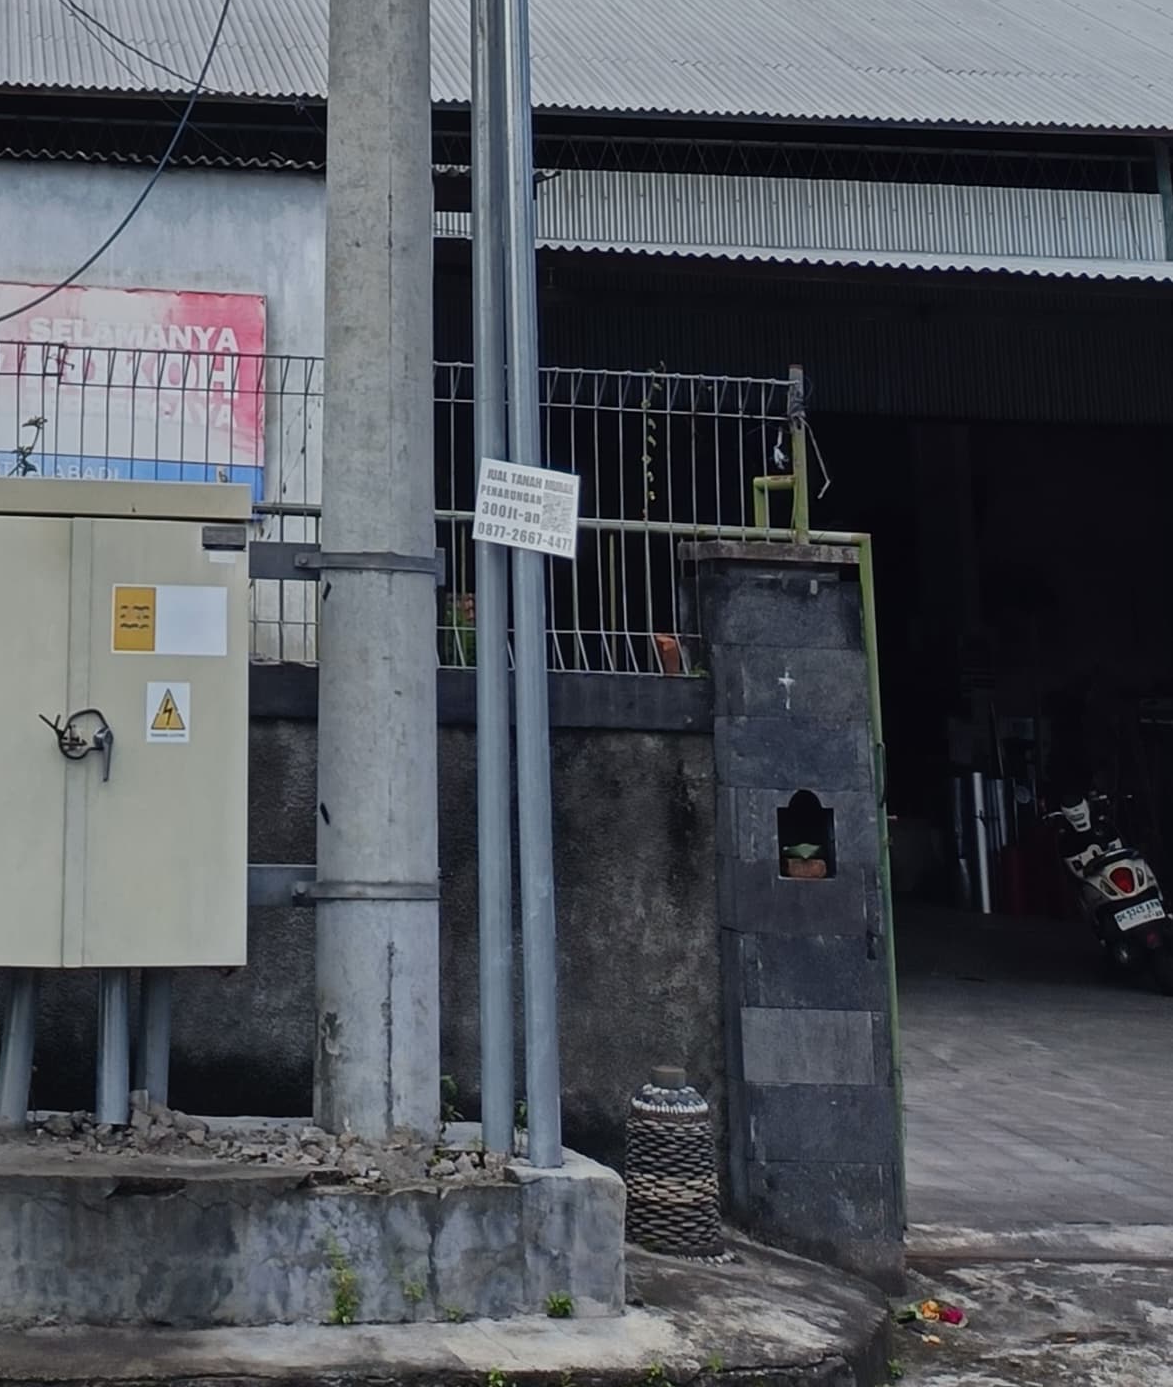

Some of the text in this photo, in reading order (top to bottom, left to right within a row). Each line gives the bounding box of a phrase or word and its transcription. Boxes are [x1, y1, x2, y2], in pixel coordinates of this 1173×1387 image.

[29, 317, 240, 353] SELAMANYA
[55, 464, 120, 479] ABADI
[487, 468, 508, 483] JUAL
[511, 472, 543, 489] TANAH
